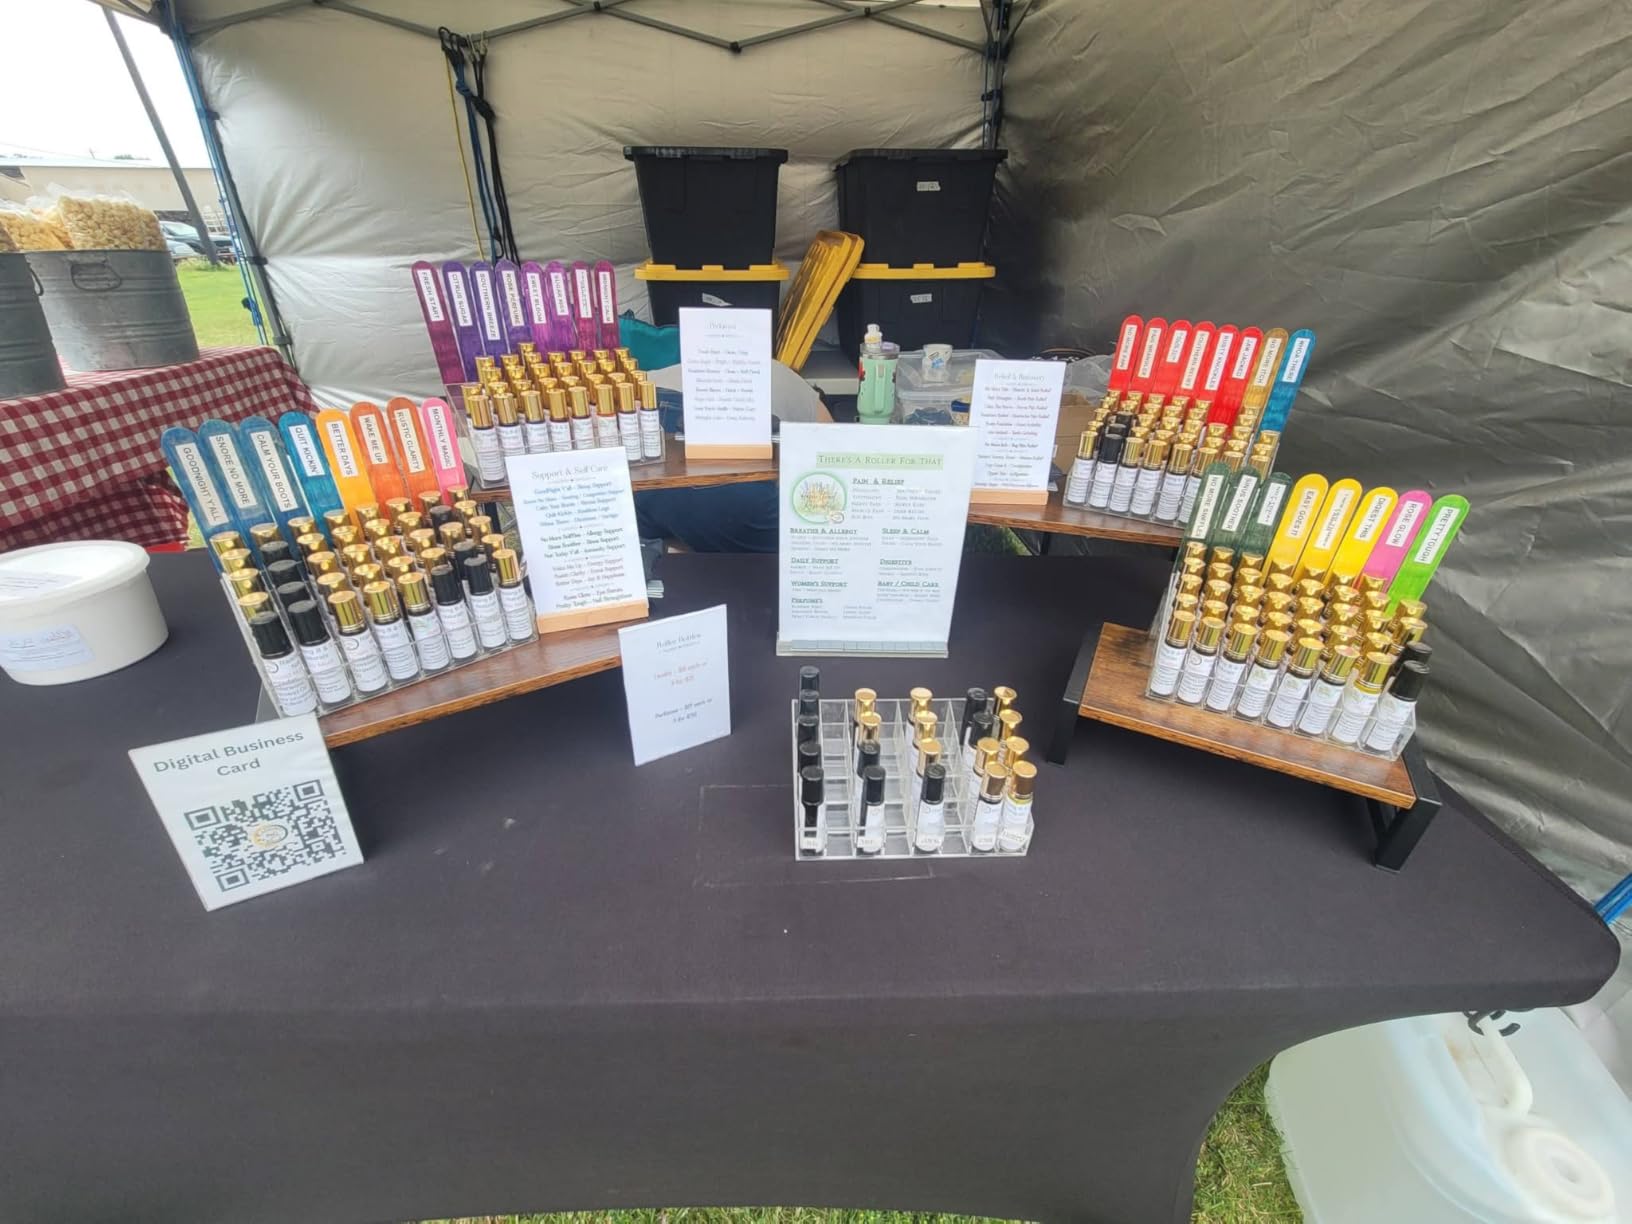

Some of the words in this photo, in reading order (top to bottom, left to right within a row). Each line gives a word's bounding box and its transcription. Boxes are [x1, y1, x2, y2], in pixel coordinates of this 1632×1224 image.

[421, 272, 433, 296] FRESH
[429, 297, 440, 319] START
[452, 274, 463, 299] CITRUS
[479, 273, 491, 310] SOUTHERN
[294, 427, 308, 445] QUIT
[363, 417, 376, 437] WAKE
[432, 409, 446, 443] MONTHLY
[441, 445, 452, 467] MAGIC
[215, 436, 234, 466] SNORE
[331, 423, 346, 453] BETTER
[341, 455, 353, 475] DAYS
[370, 440, 379, 450] ME
[397, 412, 411, 439] RUSTIC
[406, 440, 421, 470] CLARITY
[374, 452, 383, 463] UP
[229, 468, 240, 480] NO
[256, 434, 271, 456] CALM
[266, 458, 281, 479] YOUR
[275, 481, 292, 508] BOOTS
[1210, 477, 1218, 486] NO
[182, 447, 211, 498] GOODNIGHT
[205, 499, 222, 521] Y'ALL
[234, 481, 250, 505] MORE
[1204, 488, 1215, 506] MORE
[1301, 491, 1314, 508] EASY
[1293, 510, 1307, 529] GOES
[1367, 497, 1386, 523] DIGEST
[1401, 503, 1418, 524] ROSE
[1391, 524, 1407, 544] GLOW
[1432, 509, 1454, 537] PRETTY
[1419, 538, 1439, 562] TOUGH
[153, 748, 219, 773] Digital
[223, 731, 304, 758] Business
[217, 758, 261, 777] Card
